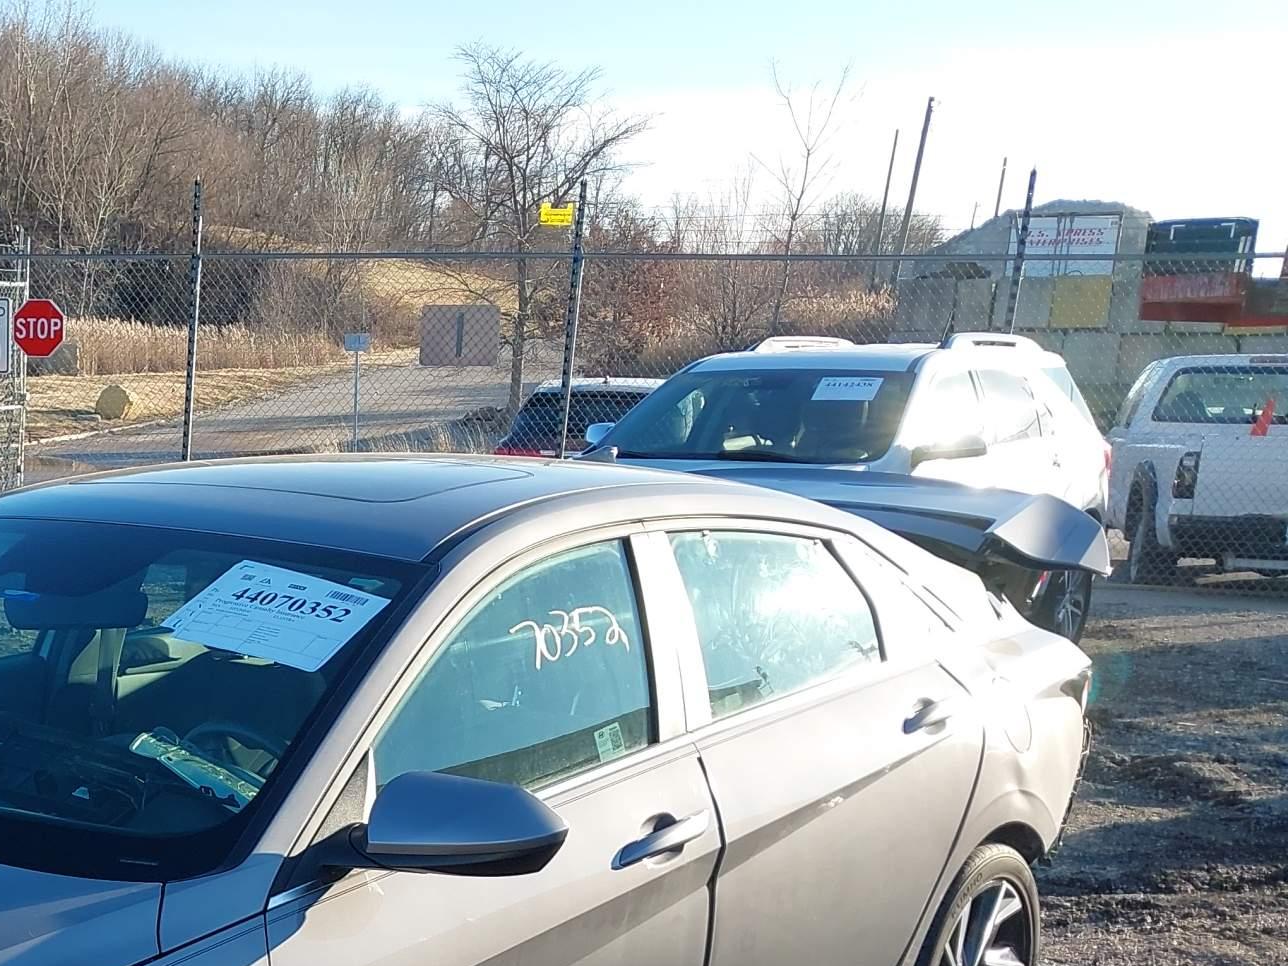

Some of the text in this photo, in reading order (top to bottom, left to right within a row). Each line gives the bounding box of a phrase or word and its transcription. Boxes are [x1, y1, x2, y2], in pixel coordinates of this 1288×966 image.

[15, 317, 62, 339] STOP
[231, 587, 352, 623] 44070352
[509, 605, 630, 671] 70352
